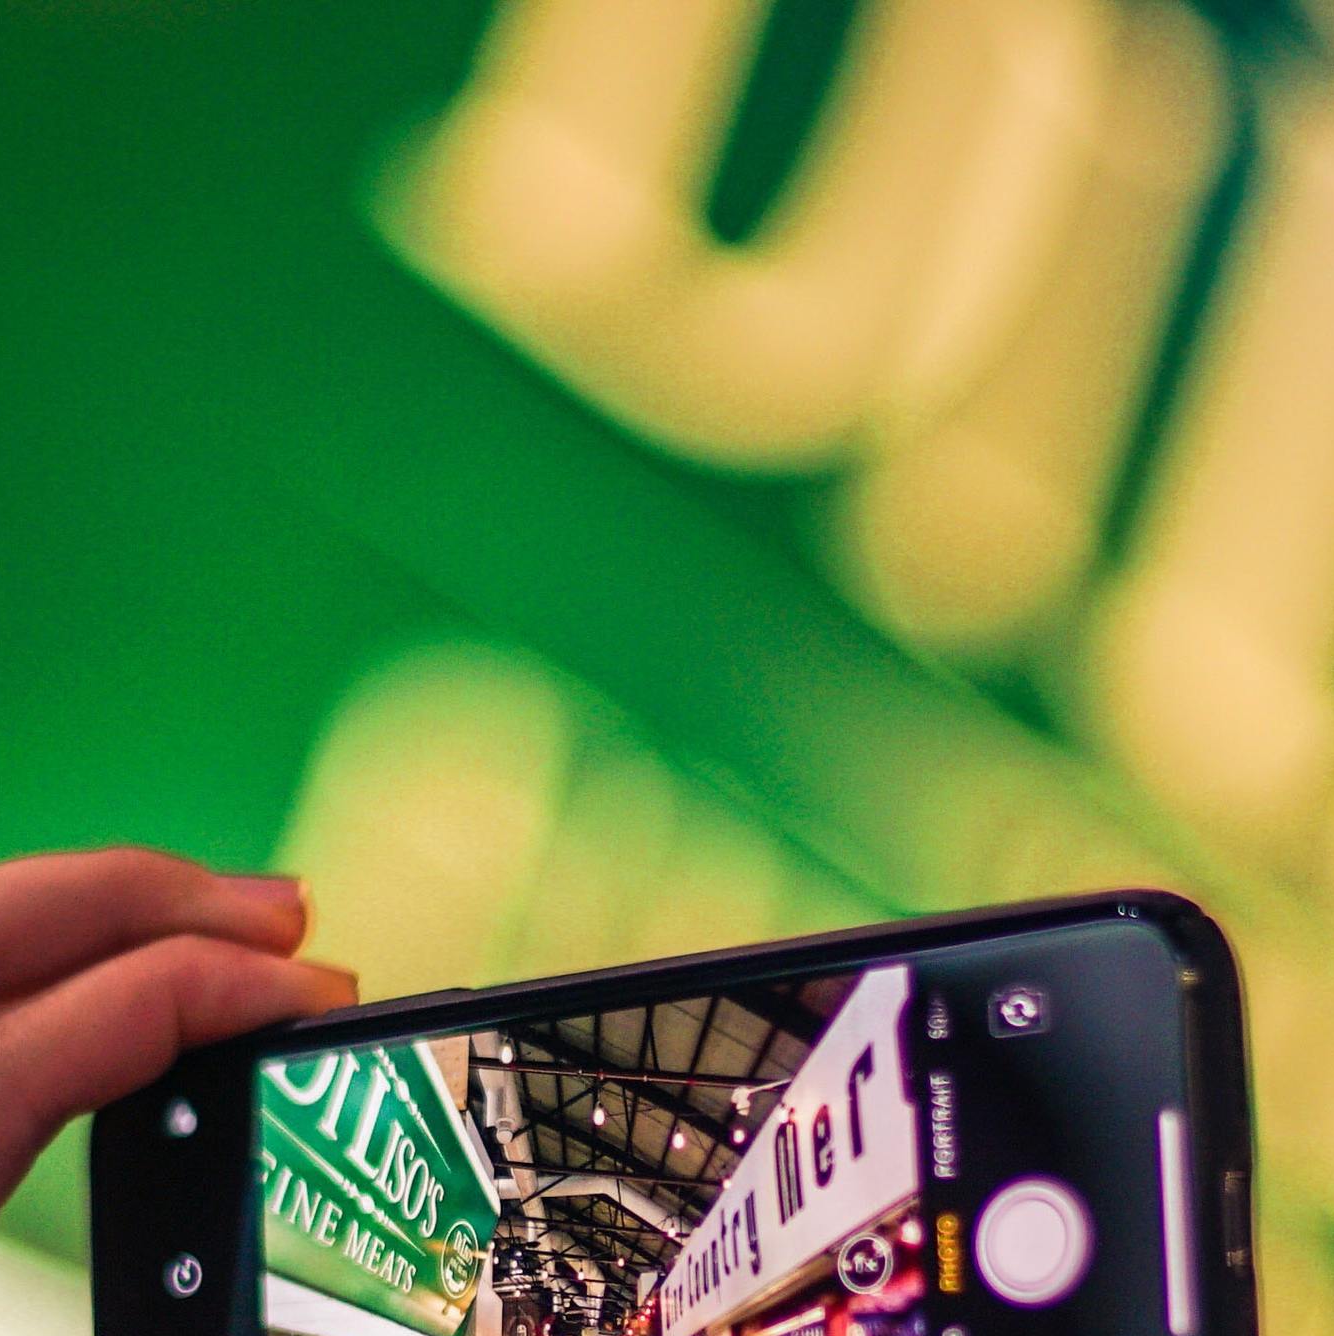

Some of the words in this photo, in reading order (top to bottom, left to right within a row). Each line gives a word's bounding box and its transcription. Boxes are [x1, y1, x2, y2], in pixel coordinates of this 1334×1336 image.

[929, 1073, 956, 1179] PORTRAIT
[342, 1220, 418, 1294] MEATS
[687, 1190, 761, 1308] Country
[936, 1213, 961, 1292] PHOTO
